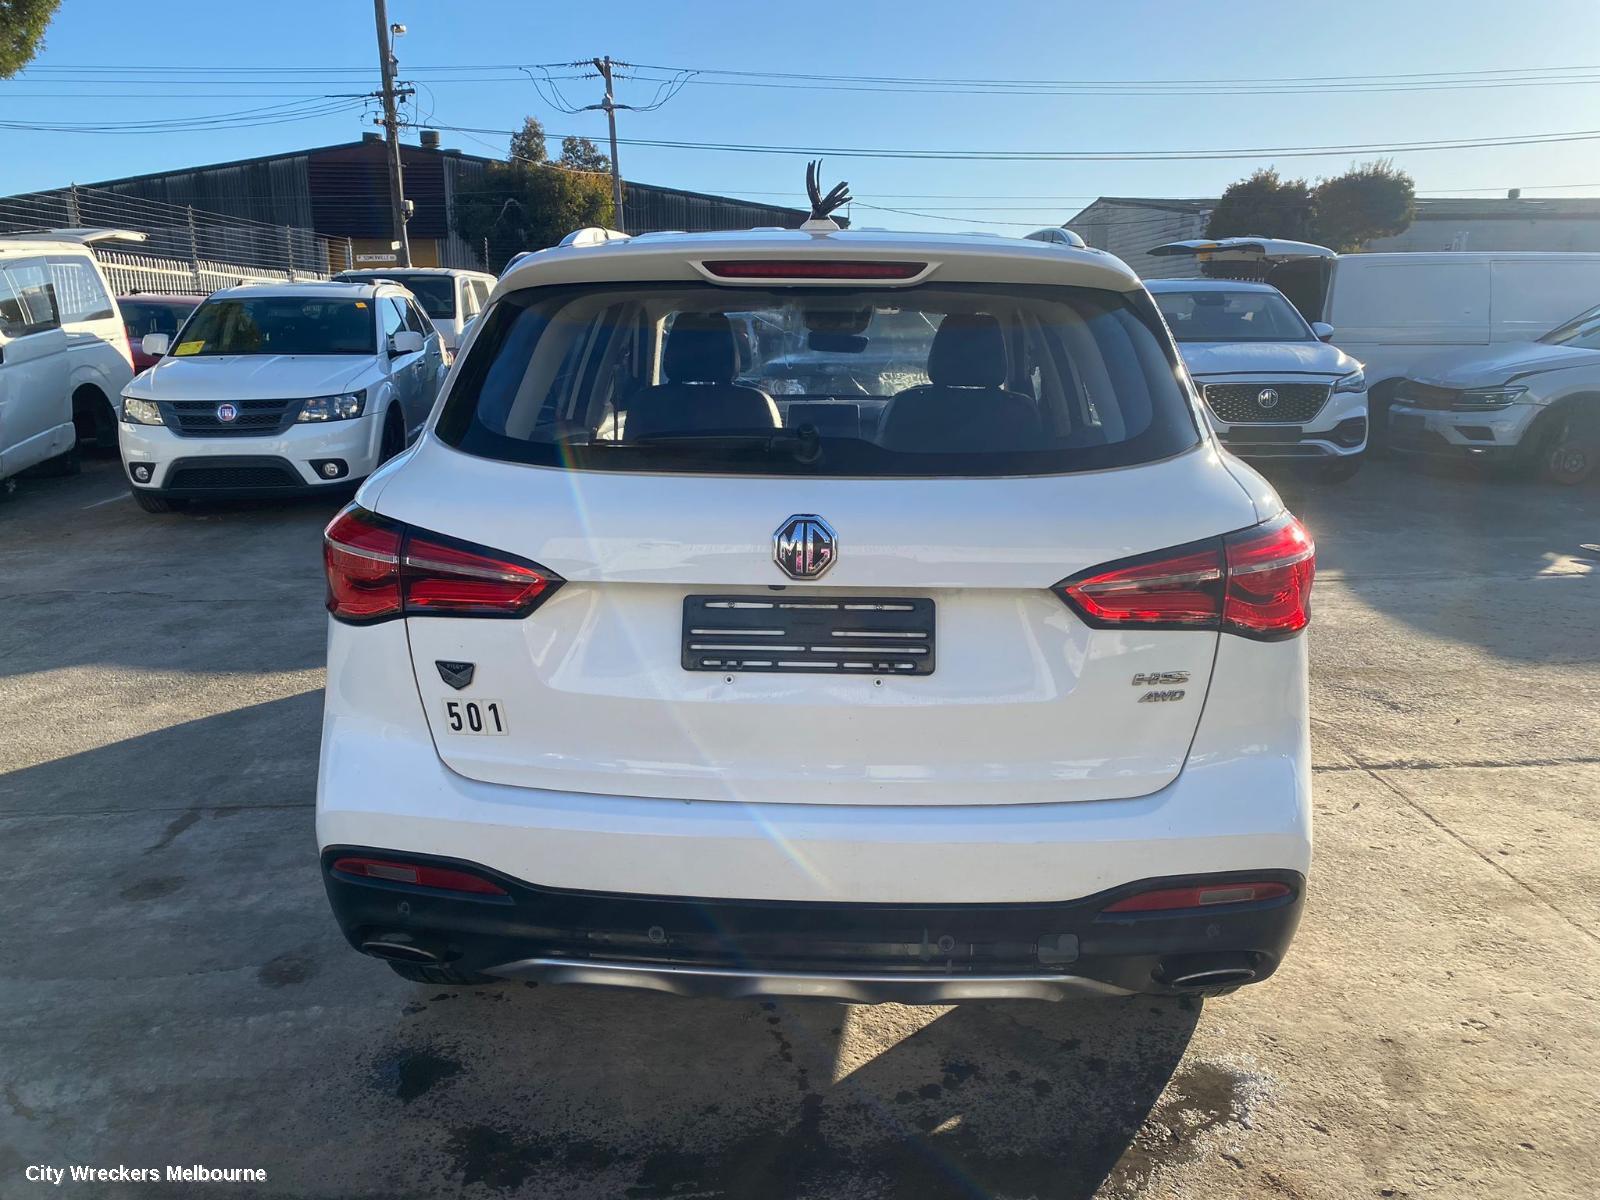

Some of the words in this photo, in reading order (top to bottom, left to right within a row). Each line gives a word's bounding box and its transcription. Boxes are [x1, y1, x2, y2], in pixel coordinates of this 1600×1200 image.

[779, 521, 831, 574] MG
[1131, 670, 1191, 686] HS
[1137, 689, 1186, 703] AWD
[446, 701, 502, 732] 501
